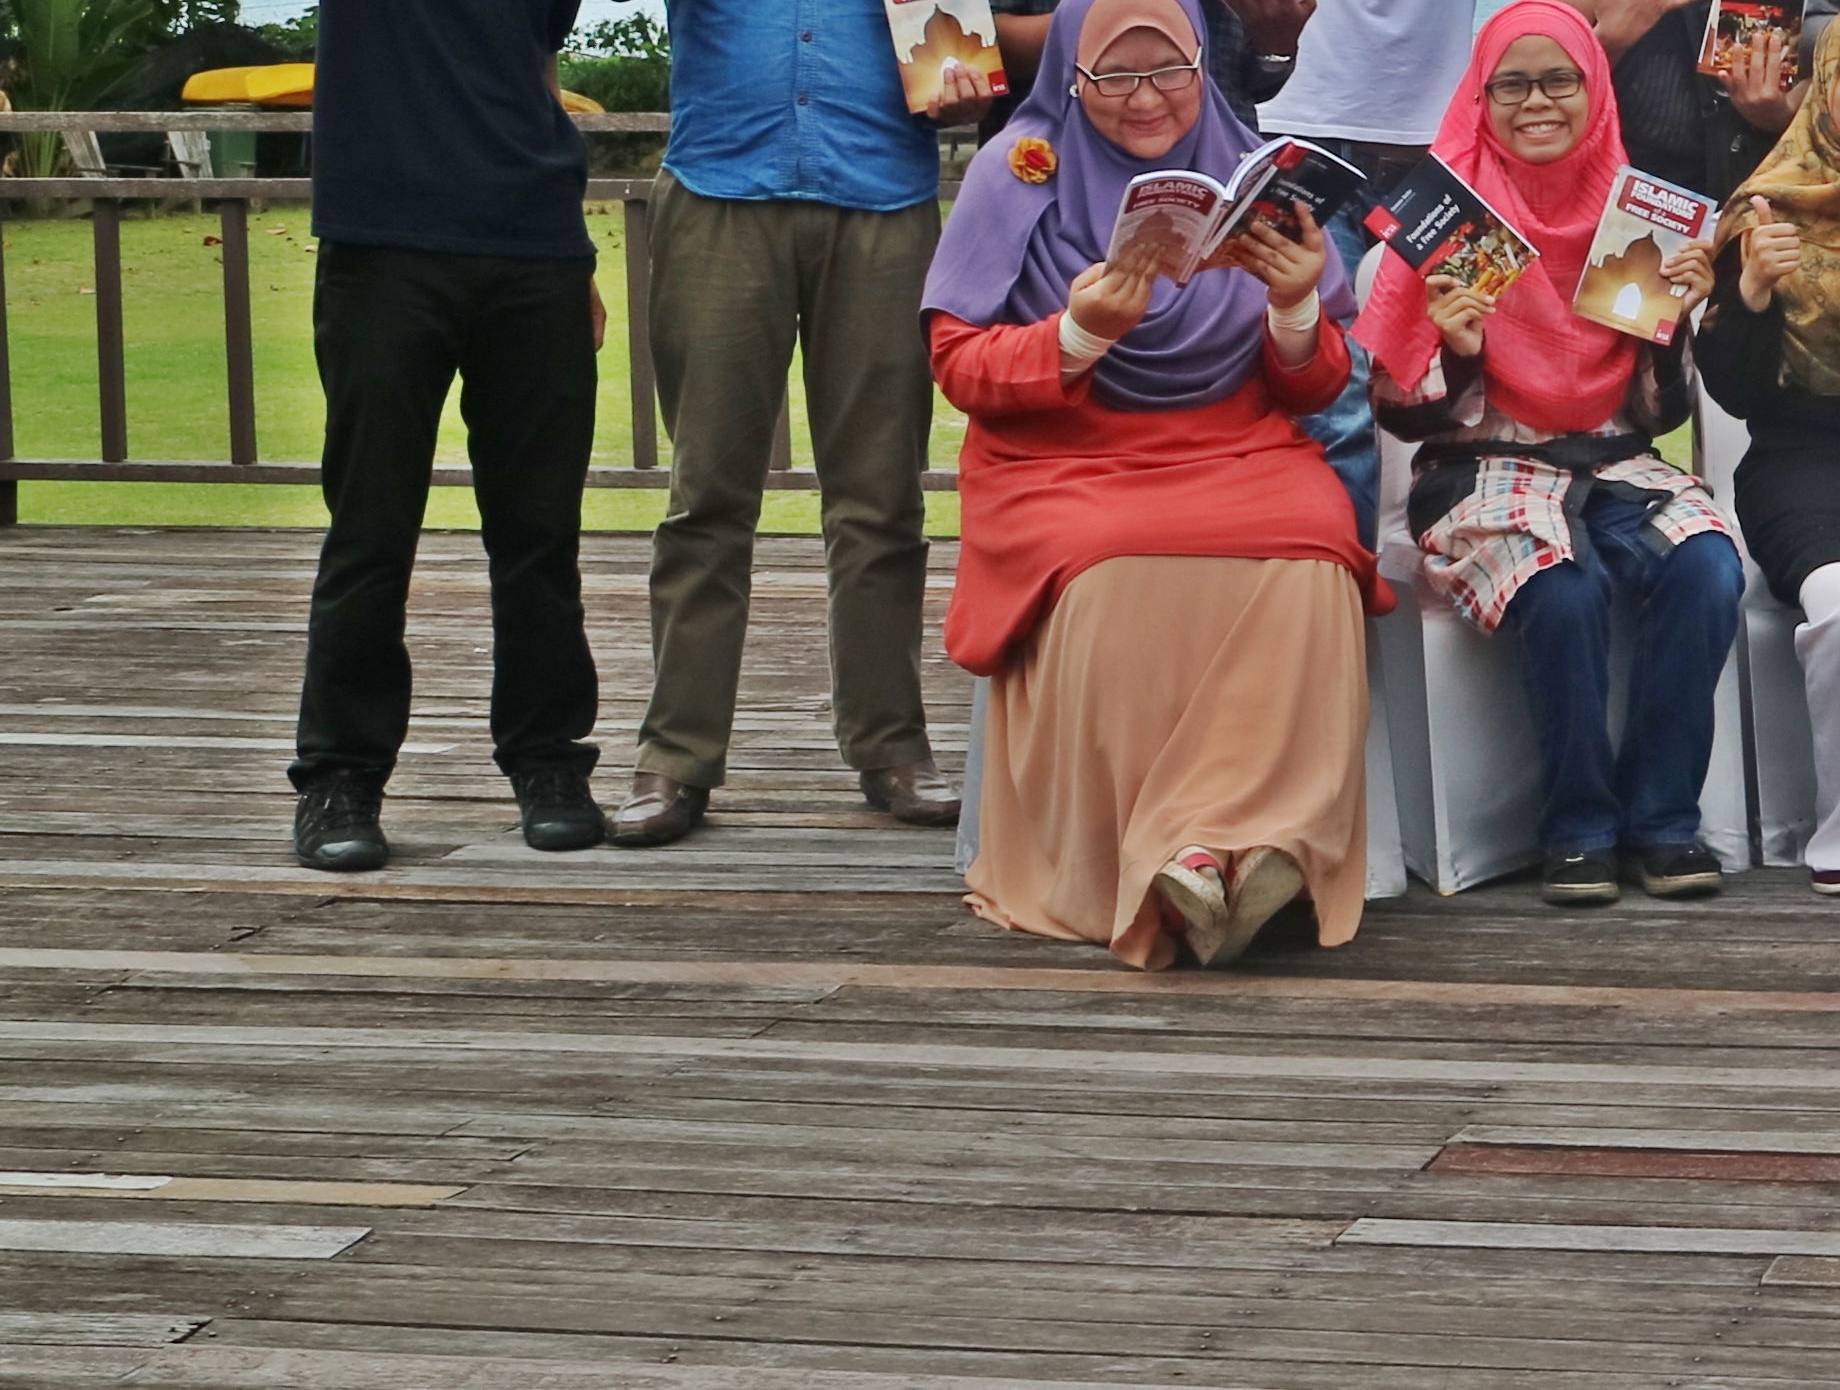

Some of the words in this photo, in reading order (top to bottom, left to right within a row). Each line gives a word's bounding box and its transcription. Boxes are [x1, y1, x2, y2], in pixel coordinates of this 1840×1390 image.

[1140, 181, 1209, 197] ISLAMIC
[1630, 190, 1696, 221] FOUNDATIONS
[1632, 179, 1699, 215] ISLAMIC
[1405, 203, 1445, 244] Foundations
[1442, 193, 1453, 205] of
[1420, 228, 1438, 245] Free
[1434, 203, 1461, 230] Society
[1625, 202, 1650, 219] FREE
[1650, 213, 1691, 234] SOCIETY
